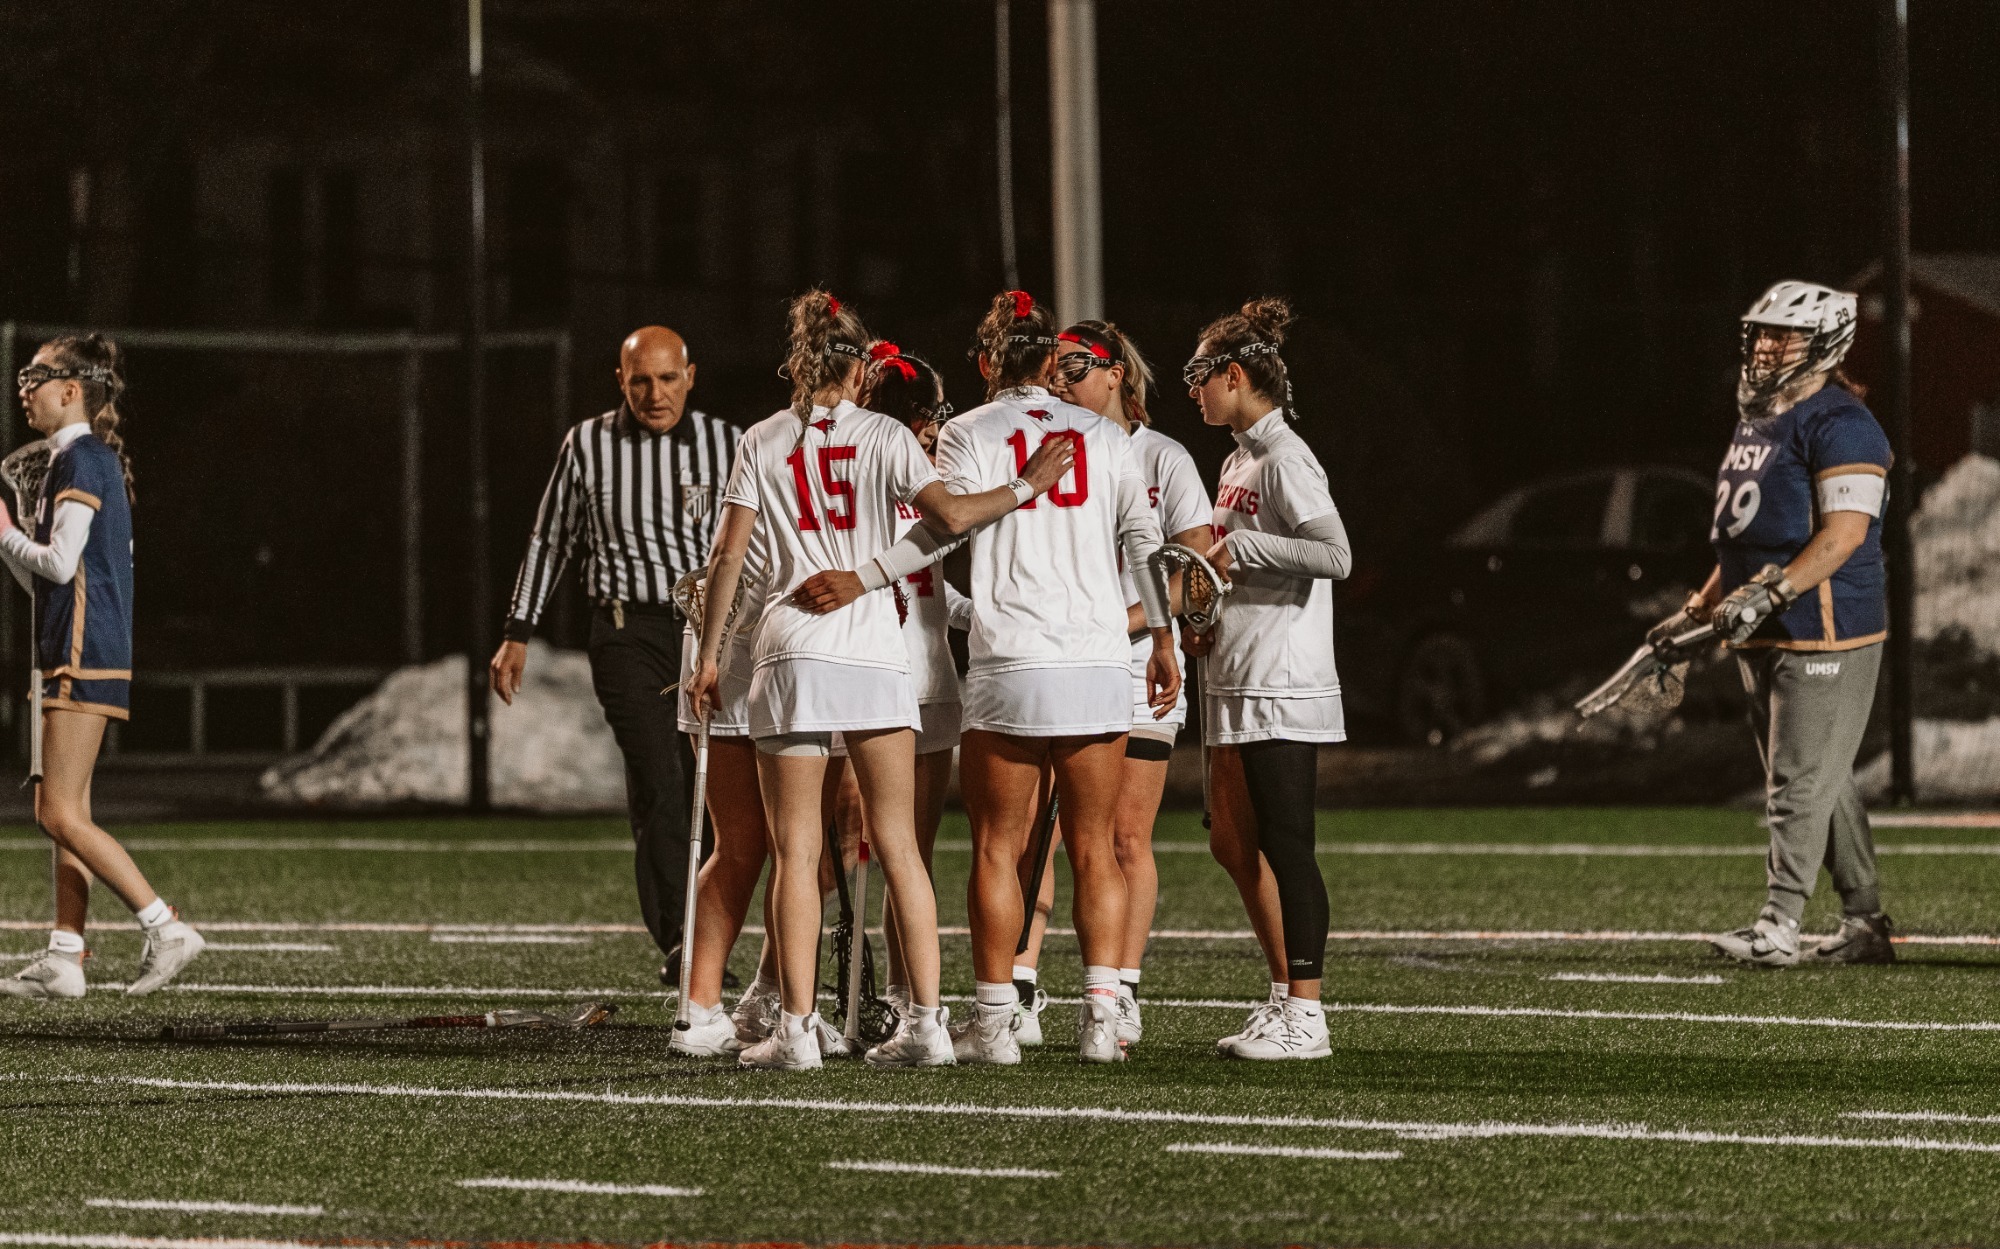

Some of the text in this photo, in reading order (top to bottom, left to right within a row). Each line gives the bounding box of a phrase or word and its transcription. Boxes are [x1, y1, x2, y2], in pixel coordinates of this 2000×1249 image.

[1834, 307, 1851, 327] 29
[834, 342, 859, 356] STX
[1036, 336, 1052, 345] STX
[1240, 340, 1267, 355] STX
[1721, 443, 1772, 471] MSV
[1006, 428, 1089, 510] 10
[786, 445, 858, 531] 15
[1805, 661, 1841, 676] UMSV
